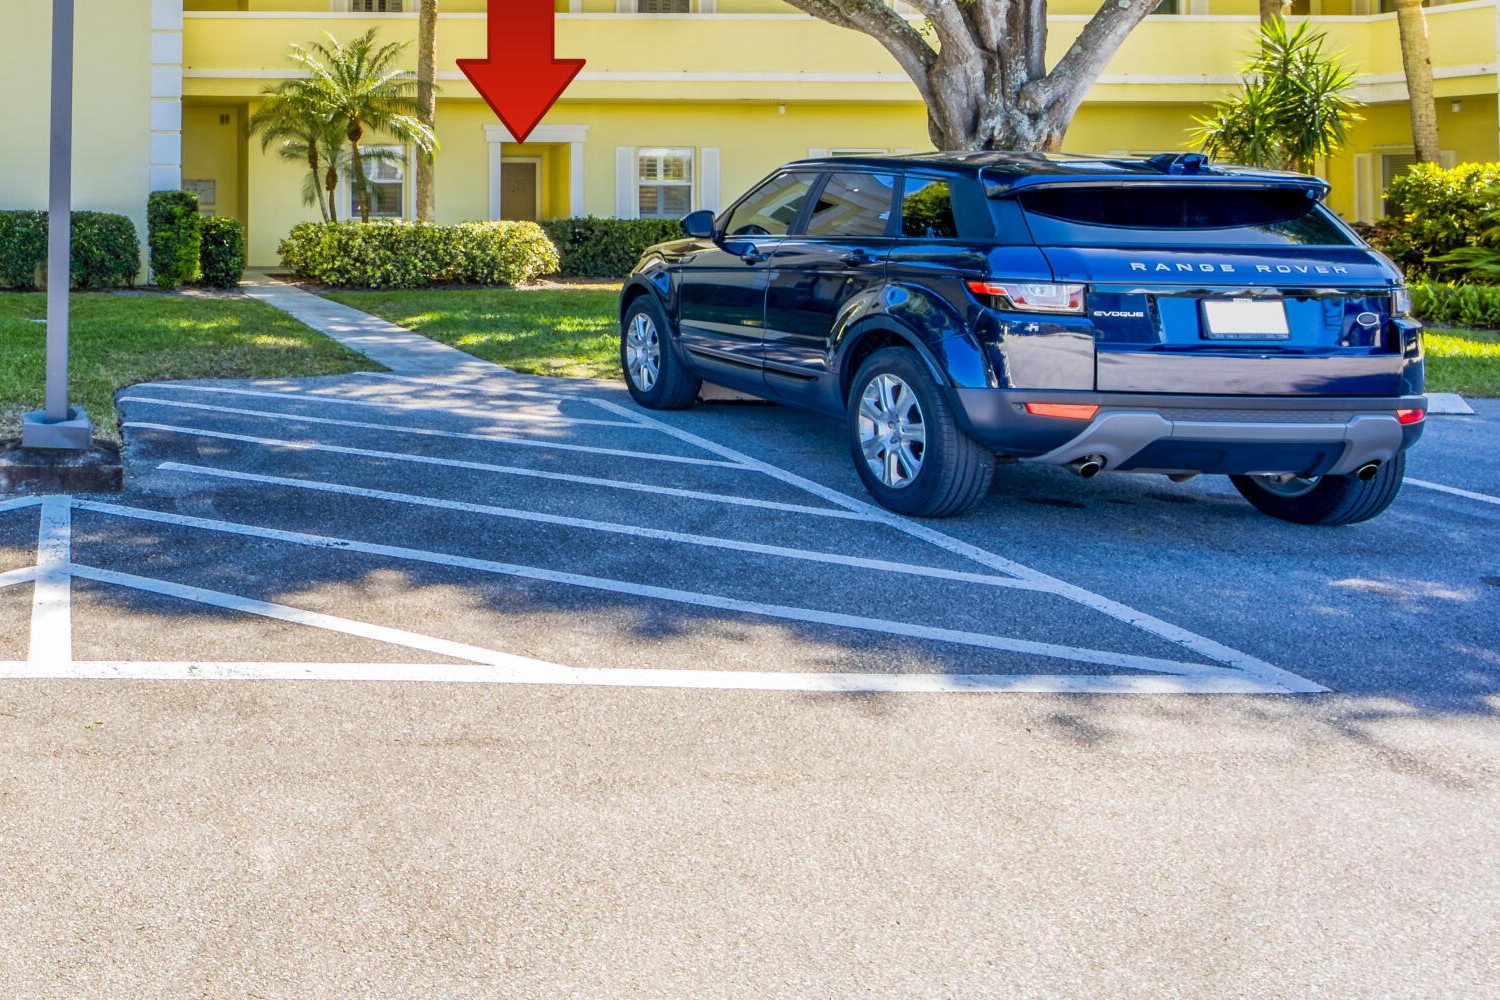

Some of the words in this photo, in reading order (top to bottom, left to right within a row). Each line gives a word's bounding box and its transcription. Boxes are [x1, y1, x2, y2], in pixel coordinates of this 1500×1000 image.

[1130, 262, 1236, 273] RANGE
[1255, 264, 1349, 275] ROVER
[1093, 310, 1145, 318] EVOQUE
